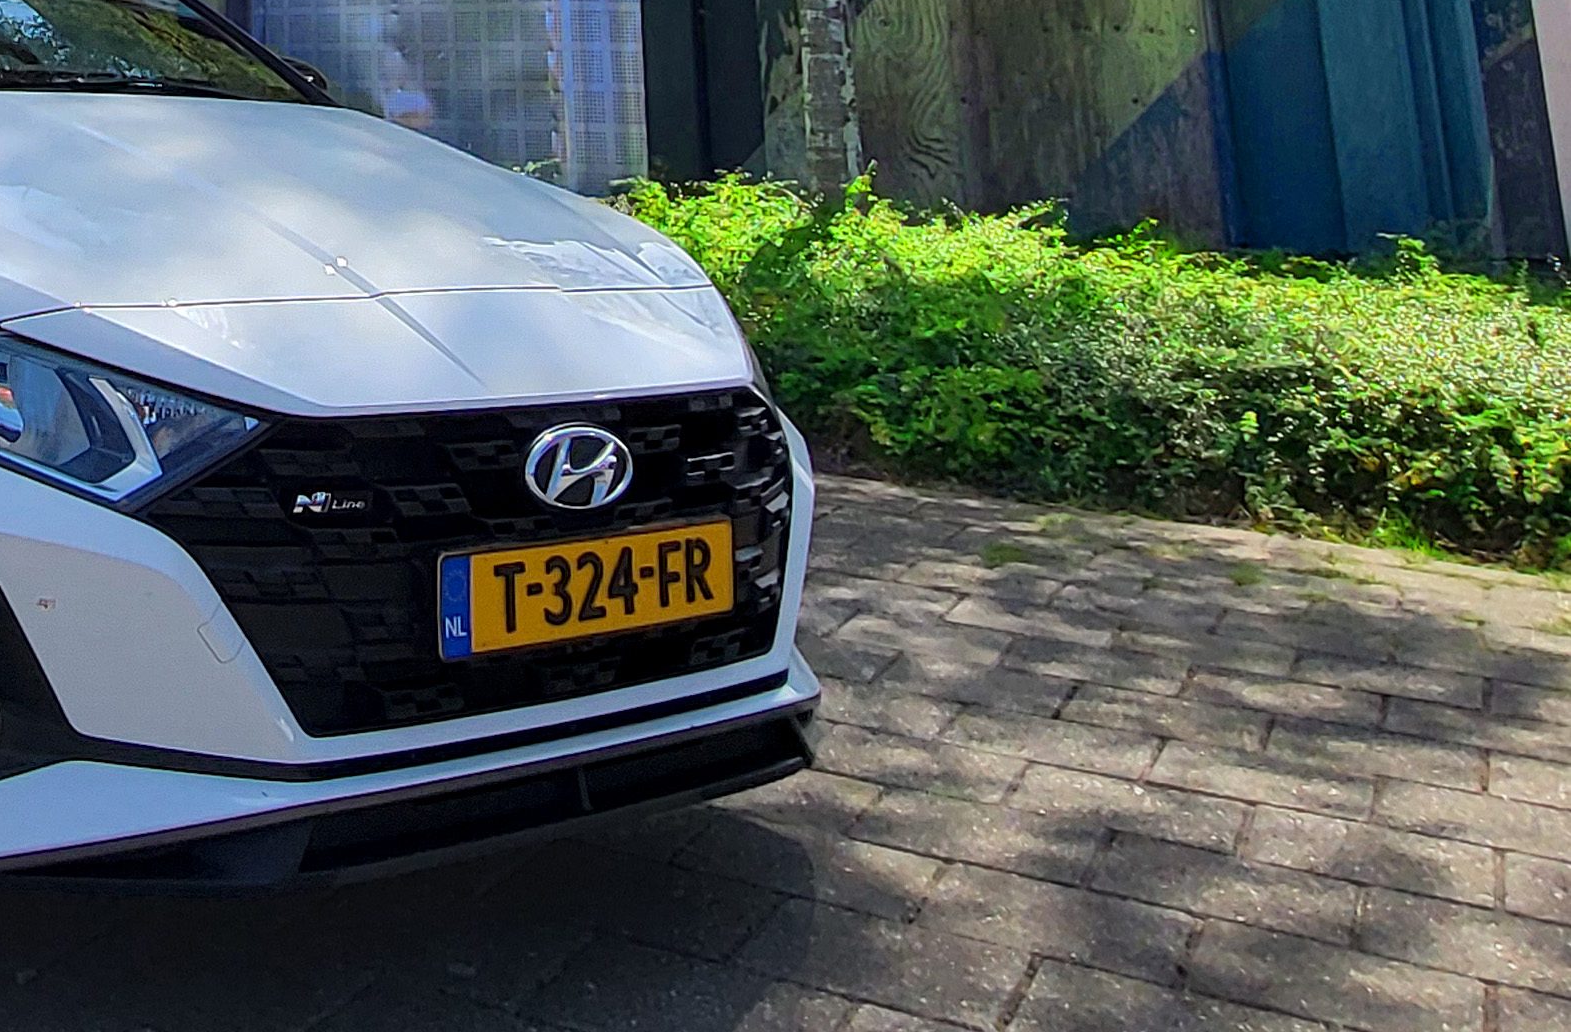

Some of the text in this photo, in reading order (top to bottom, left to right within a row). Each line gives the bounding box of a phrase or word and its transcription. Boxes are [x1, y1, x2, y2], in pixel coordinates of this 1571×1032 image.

[332, 499, 365, 510] Line
[494, 538, 714, 634] T-324-FR
[445, 615, 468, 639] NL
